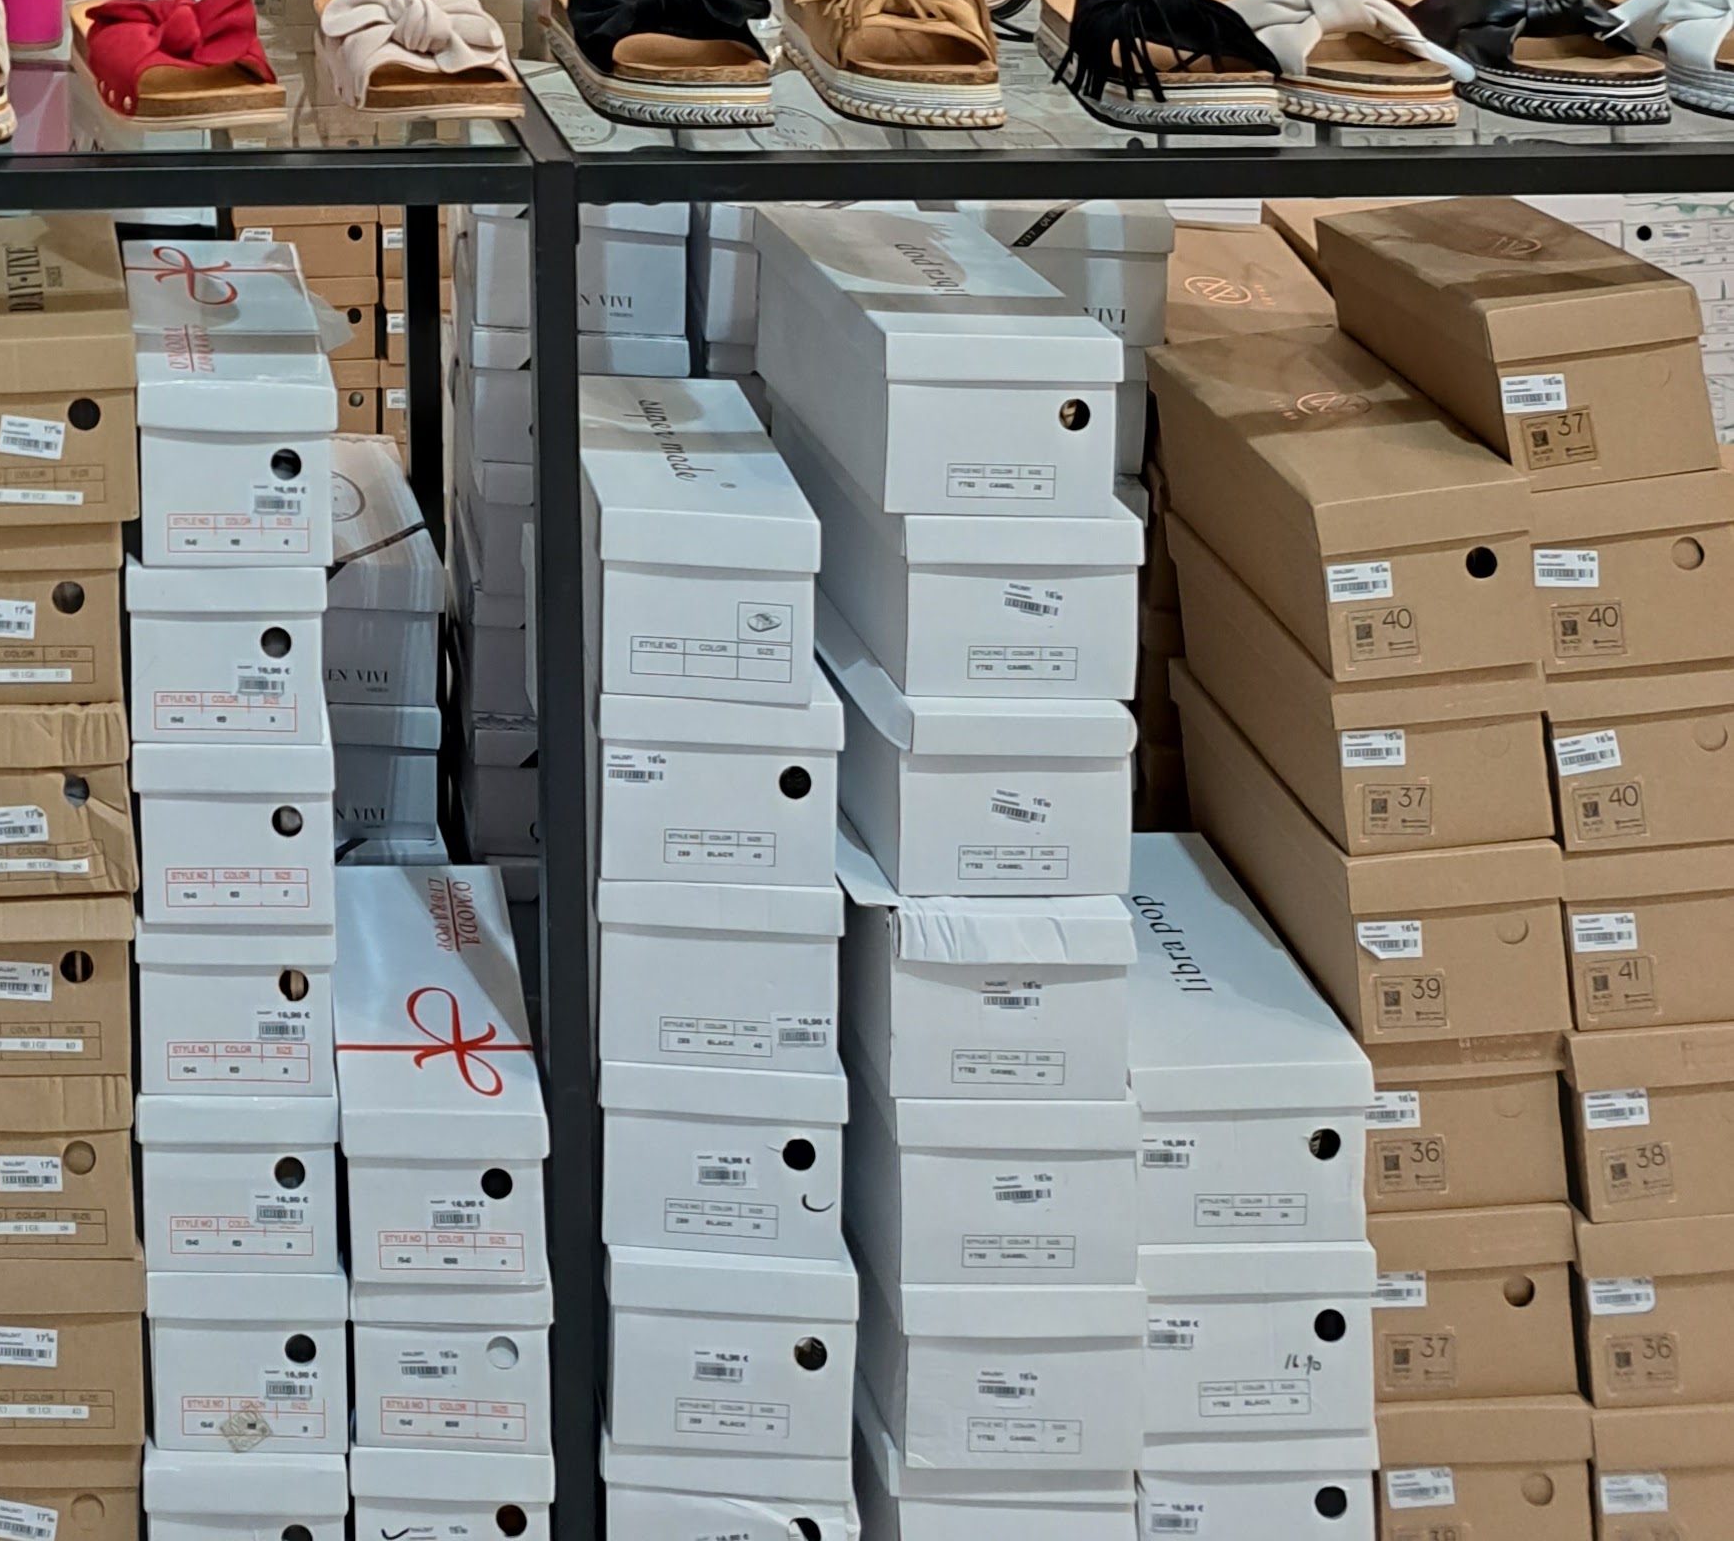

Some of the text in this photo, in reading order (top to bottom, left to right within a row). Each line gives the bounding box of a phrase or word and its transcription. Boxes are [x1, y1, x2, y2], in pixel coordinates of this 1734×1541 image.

[623, 399, 676, 439] super
[1557, 412, 1584, 437] 37
[661, 442, 716, 482] mode
[1382, 608, 1413, 630] 40
[1588, 606, 1619, 629] 40
[1397, 786, 1428, 809] 37
[1608, 784, 1640, 807] 40
[452, 881, 481, 946] O'MODA
[1132, 895, 1184, 934] pop
[1162, 940, 1213, 993] libra
[1618, 960, 1640, 981] 41
[1411, 978, 1442, 1000] 39
[225, 1044, 252, 1055] COLOR
[1410, 1140, 1441, 1163] 36
[1636, 1145, 1667, 1169] 38
[436, 1234, 466, 1245] COLOR
[1420, 1336, 1449, 1359] 37
[1642, 1337, 1673, 1360] 36
